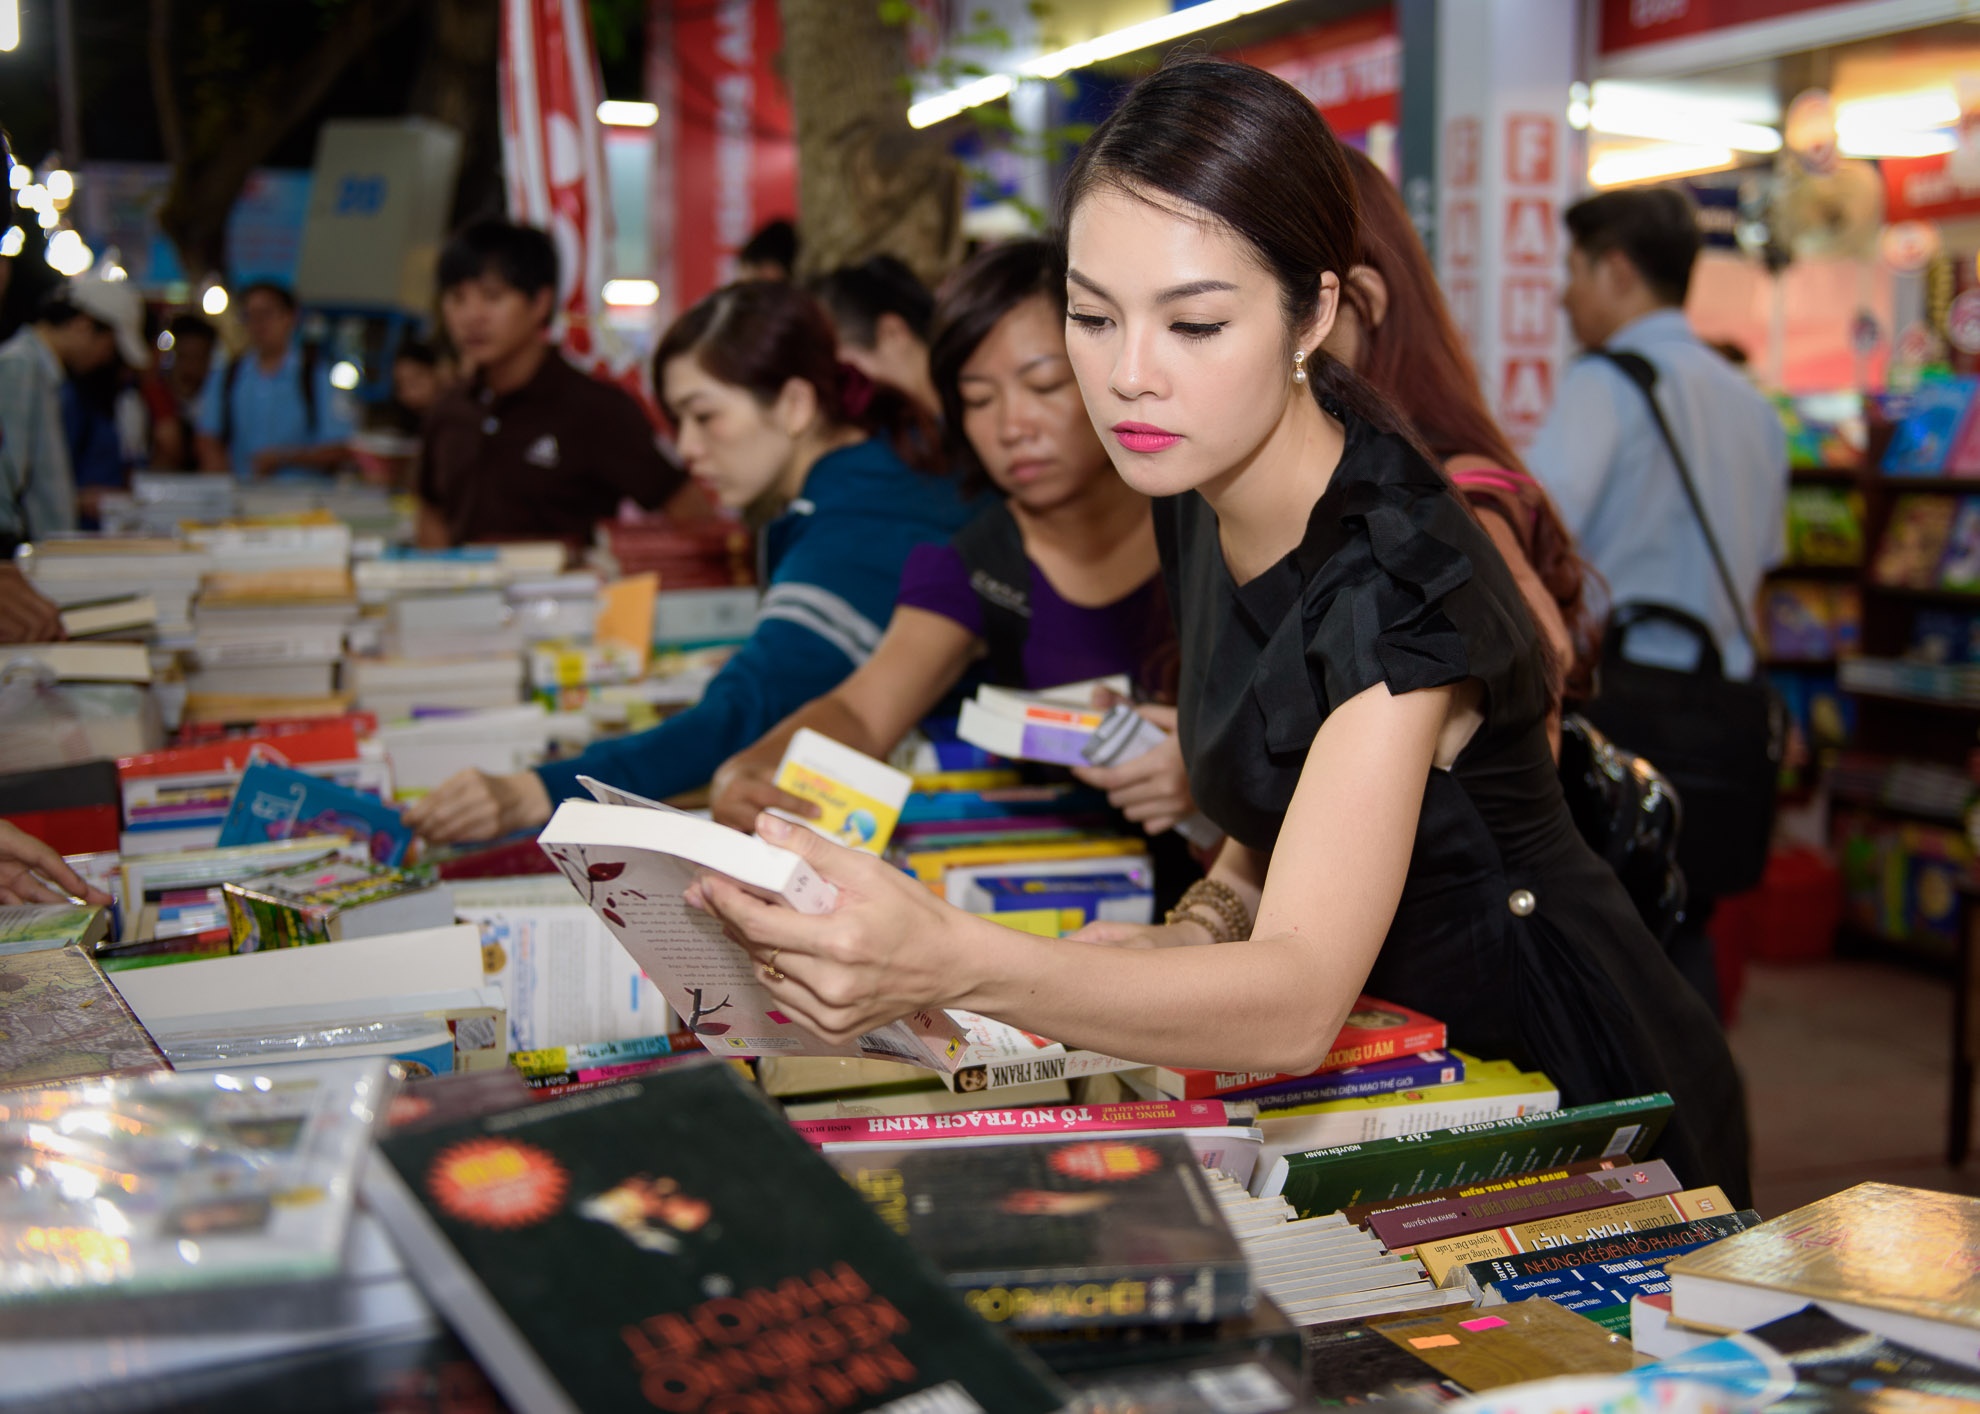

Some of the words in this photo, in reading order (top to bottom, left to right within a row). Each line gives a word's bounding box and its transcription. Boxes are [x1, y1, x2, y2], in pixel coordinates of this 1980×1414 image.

[991, 1061, 1033, 1087] FRANK
[1033, 1057, 1067, 1081] ANNE
[1215, 1071, 1247, 1091] Mario
[935, 1110, 1017, 1131] TRẠCH
[1021, 1108, 1055, 1131] NỮ
[1061, 1106, 1092, 1130] TỐ
[1141, 1108, 1176, 1120] PHONG
[1448, 1120, 1500, 1136] GUITAR
[1395, 1134, 1404, 1143] 2
[1613, 1198, 1667, 1218] Dictionnaire
[1523, 1219, 1571, 1236] Vietnamien
[1468, 1234, 1498, 1251] Nguyễn
[1491, 1246, 1505, 1256] Võ
[1454, 1251, 1473, 1262] Lam
[1599, 1262, 1628, 1276] Tăng
[1620, 1273, 1648, 1287] Tăng
[1639, 1282, 1666, 1297] Tăng
